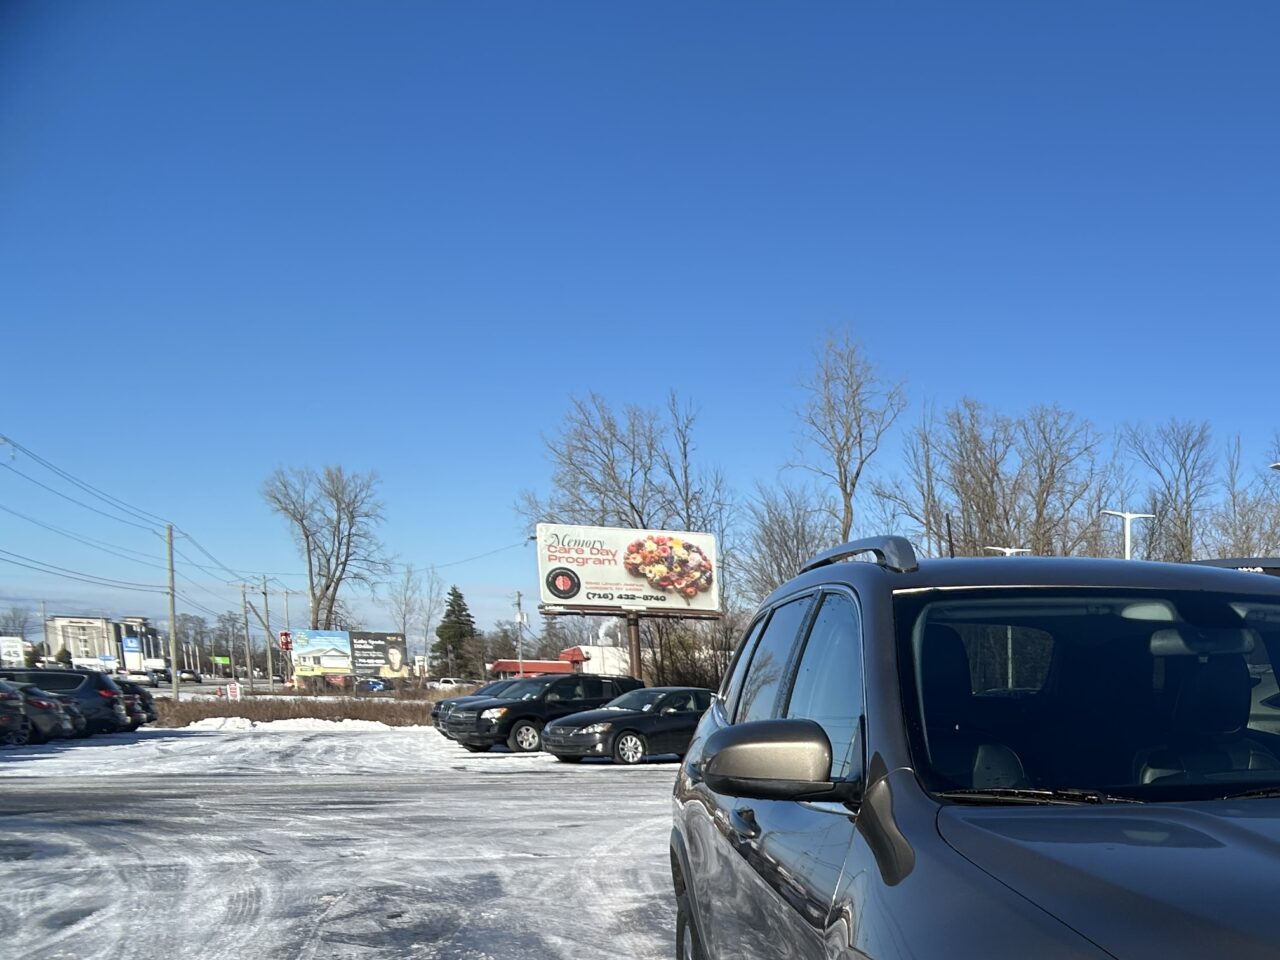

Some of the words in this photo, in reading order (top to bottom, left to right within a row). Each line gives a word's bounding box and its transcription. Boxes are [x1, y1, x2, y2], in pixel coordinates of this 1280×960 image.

[549, 533, 605, 549] Memory
[547, 544, 585, 555] Care
[590, 547, 618, 558] Day
[547, 554, 618, 567] Program
[3, 650, 21, 658] 45
